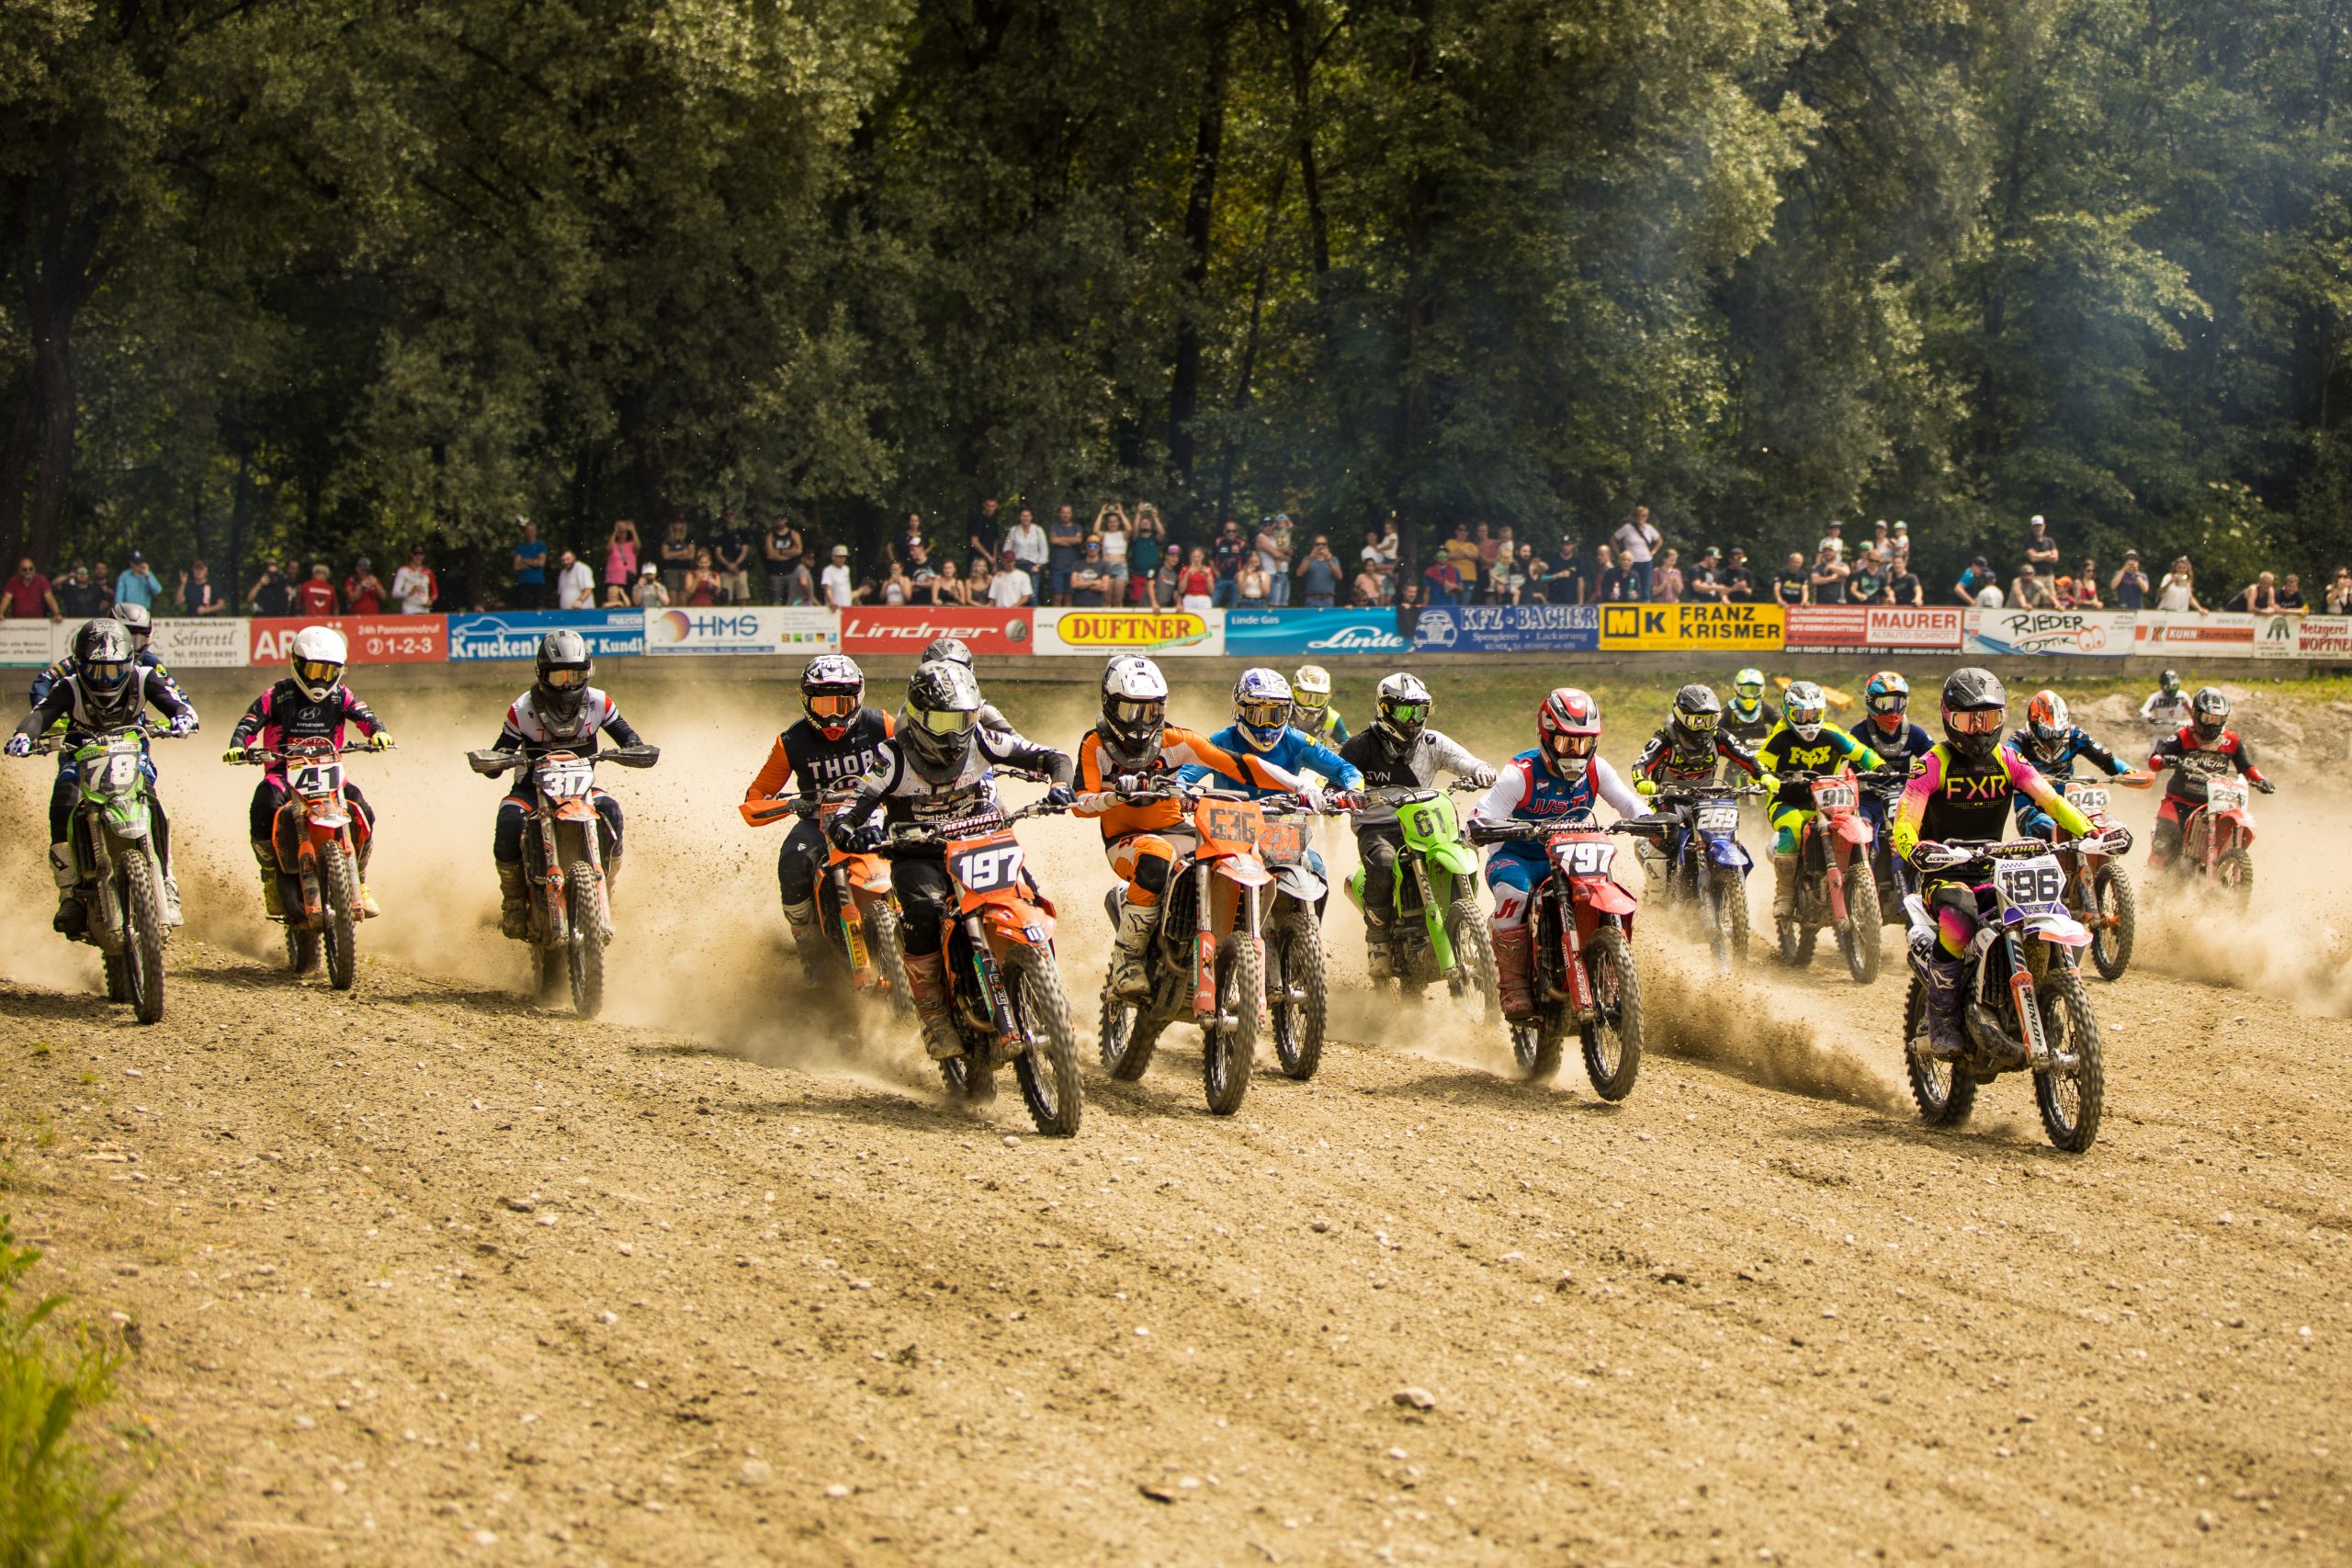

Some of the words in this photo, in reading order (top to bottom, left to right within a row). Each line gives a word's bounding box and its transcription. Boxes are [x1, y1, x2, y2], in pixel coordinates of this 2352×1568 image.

[1231, 615, 1260, 626] Linde
[1261, 616, 1280, 626] Gas
[1645, 611, 1667, 634] K
[1679, 606, 1756, 622] FRANZ
[1871, 613, 1958, 629] MAURER
[377, 623, 441, 635] Pannennotruf
[696, 615, 759, 637] HMS
[844, 619, 999, 638] Lindner
[1072, 618, 1193, 640] DUFTNER
[1679, 624, 1781, 639] KRISMER
[1871, 631, 1957, 640] ALTAUTO-SCHROTT
[2000, 615, 2085, 637] RIEDER
[2300, 623, 2348, 637] Metzgerei
[169, 628, 238, 648] Schrettl
[386, 637, 433, 655] 1-2-3
[599, 637, 643, 653] Kundl
[1307, 626, 1404, 649] Linde
[1473, 632, 1520, 643] Spenglerei
[1536, 632, 1589, 643] Lackierung
[1803, 646, 1835, 654] RADFELD
[86, 754, 138, 793] 78
[808, 749, 876, 780] THOR
[294, 766, 340, 792] 41
[543, 772, 590, 797] 317
[1946, 773, 2007, 800] FXR
[943, 814, 1001, 832] RENTHAL
[1413, 807, 1447, 838] 61
[1556, 842, 1617, 874] 797
[1990, 844, 2043, 853] RENTHAL
[958, 845, 1023, 890] 197
[2002, 868, 2059, 904] 196
[2026, 994, 2043, 1047] DUNLOP
